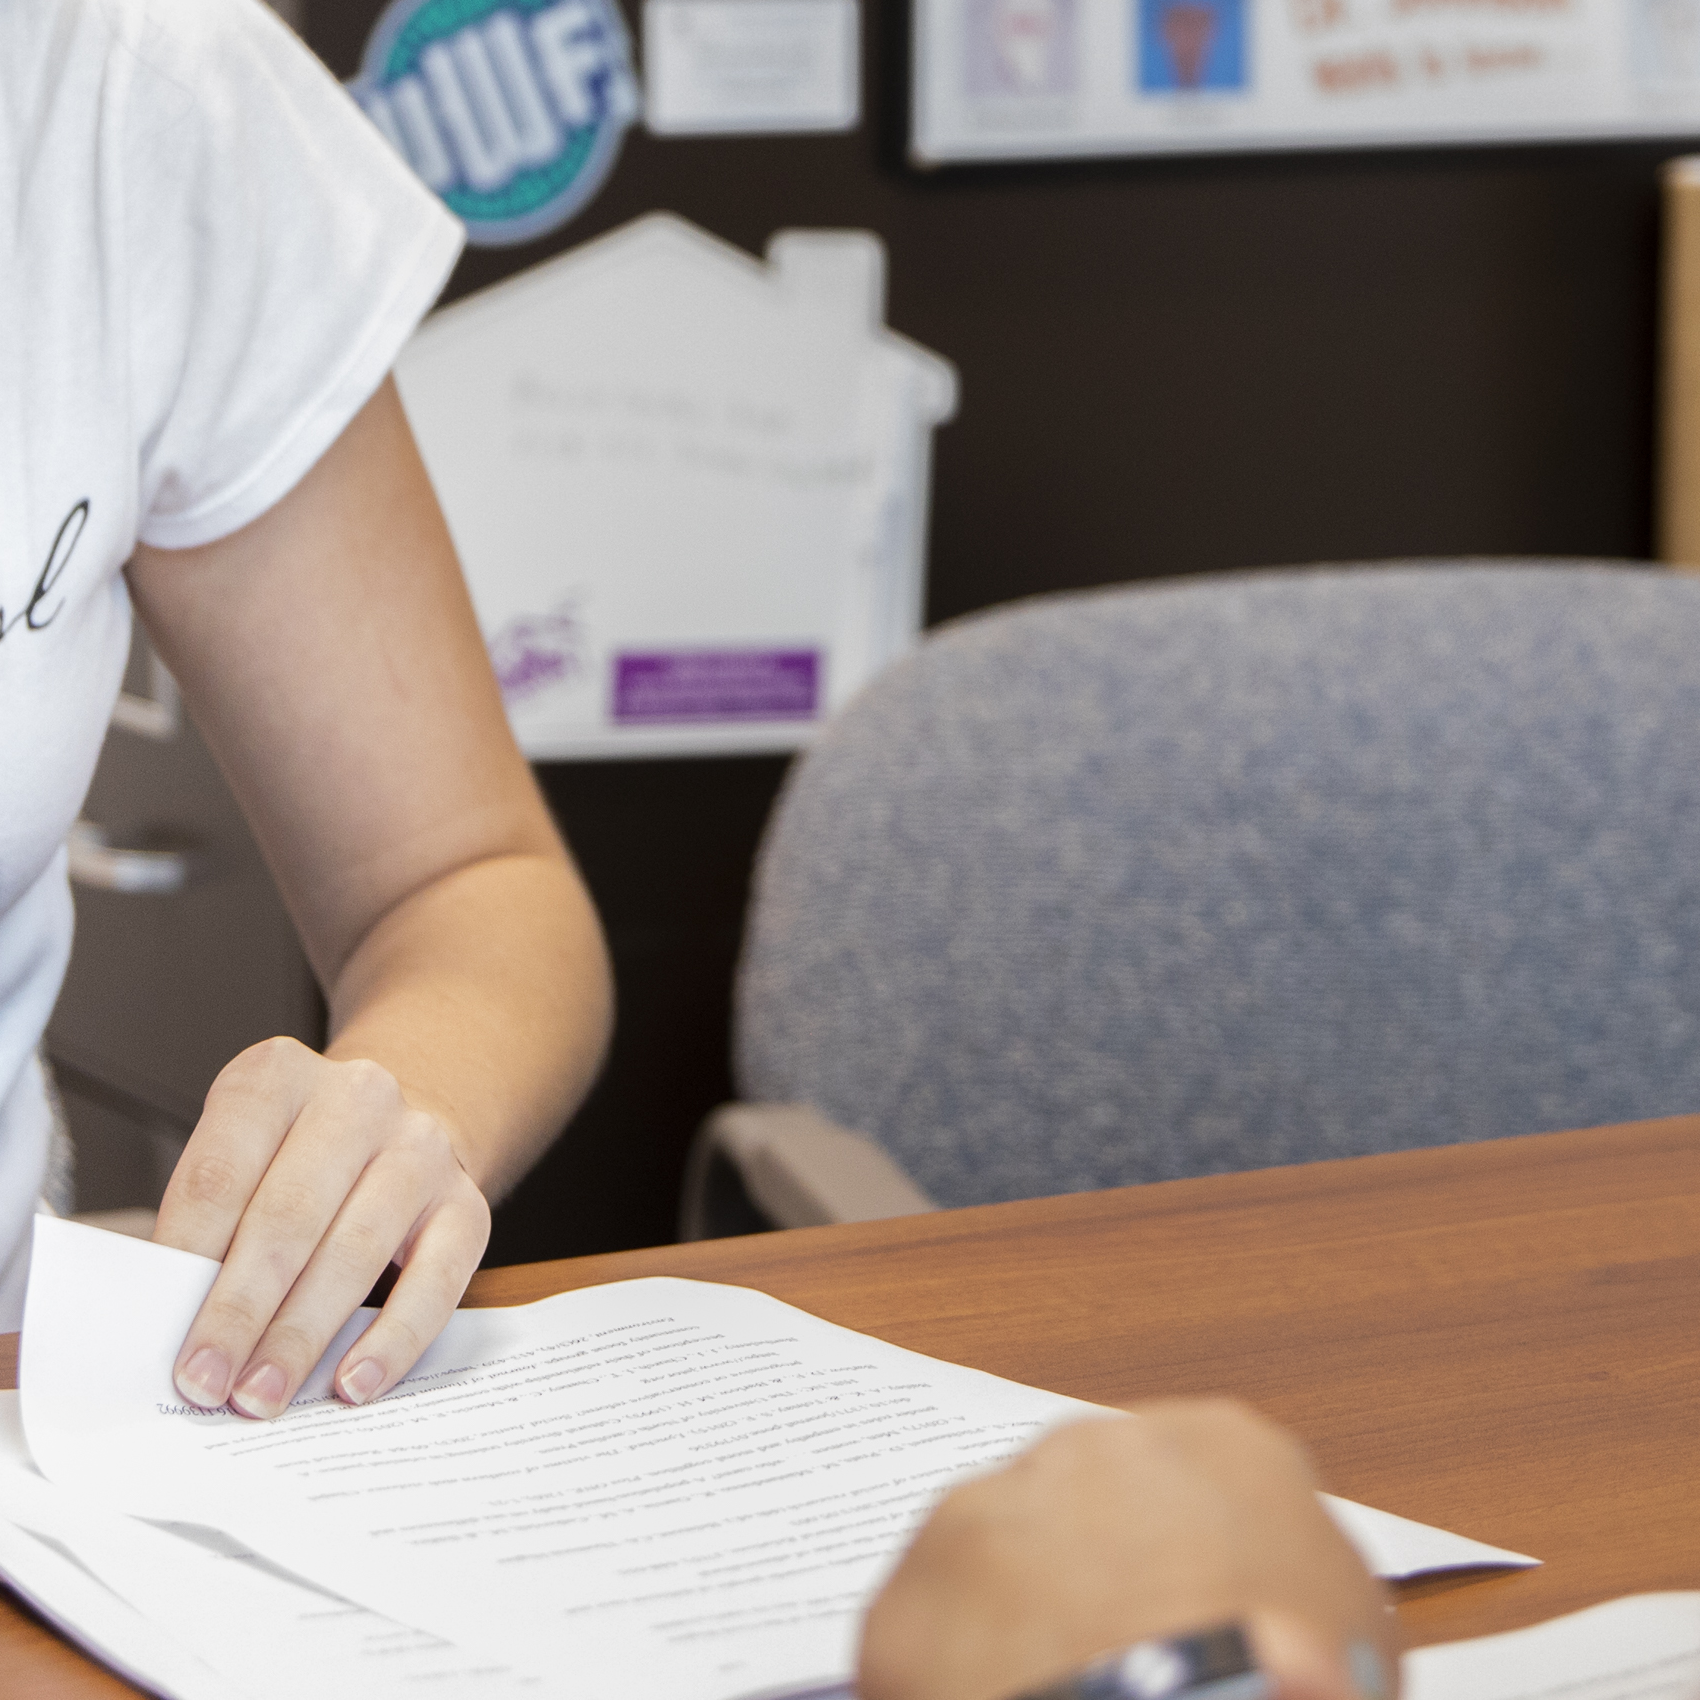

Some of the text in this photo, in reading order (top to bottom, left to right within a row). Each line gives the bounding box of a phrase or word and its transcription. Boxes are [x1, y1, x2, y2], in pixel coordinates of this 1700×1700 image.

[593, 1315, 675, 1338] Environment,
[627, 1324, 701, 1343] community
[486, 1362, 537, 1380] Journal
[523, 1360, 602, 1384] relationship
[417, 1378, 469, 1395] Human
[351, 1390, 417, 1408] Behavior
[696, 1396, 769, 1417] University
[263, 1411, 313, 1426] Social
[288, 1412, 374, 1433] enforcement
[528, 1412, 573, 1428] Social
[230, 1428, 287, 1445] surveys
[472, 1422, 526, 1438] Justice,
[541, 1453, 591, 1469] victims
[460, 1468, 522, 1483] southern
